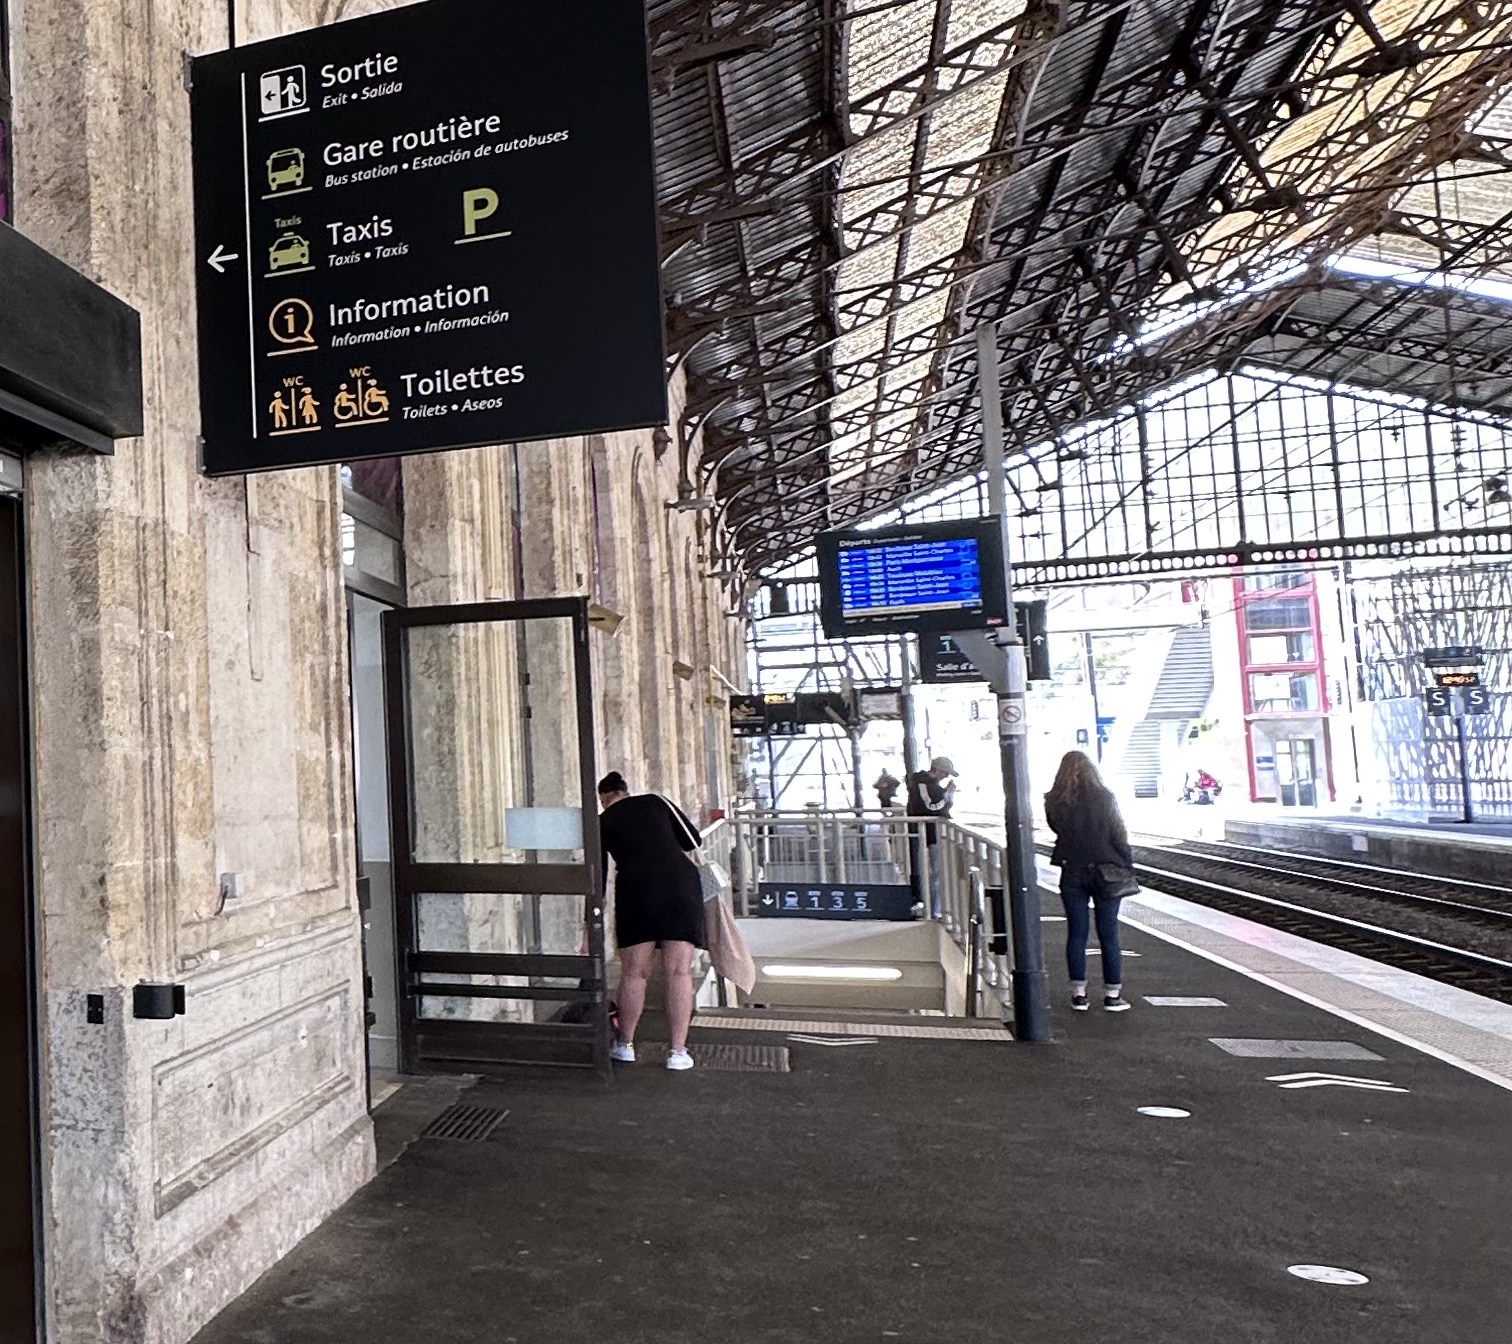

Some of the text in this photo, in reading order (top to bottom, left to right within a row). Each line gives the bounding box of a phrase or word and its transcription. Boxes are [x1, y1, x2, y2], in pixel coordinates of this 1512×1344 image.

[320, 53, 399, 87] Sortie
[322, 80, 403, 108] Exit Salida
[323, 112, 501, 166] Gare routière
[325, 128, 570, 188] Bus station Estación de autobuses
[274, 215, 302, 228] Taxis
[463, 187, 499, 235] P
[326, 215, 393, 245] Taxis
[328, 242, 409, 267] Taxis Taxis
[329, 281, 489, 327] Information
[331, 309, 509, 348] Information Información
[283, 366, 371, 387] WC WC
[400, 361, 525, 399] Toilettes
[402, 395, 503, 421] Toilets Aseos
[1432, 692, 1445, 705] S
[1470, 691, 1483, 704] S
[810, 896, 819, 908] 1
[833, 897, 843, 909] 3
[856, 898, 867, 909] 5
